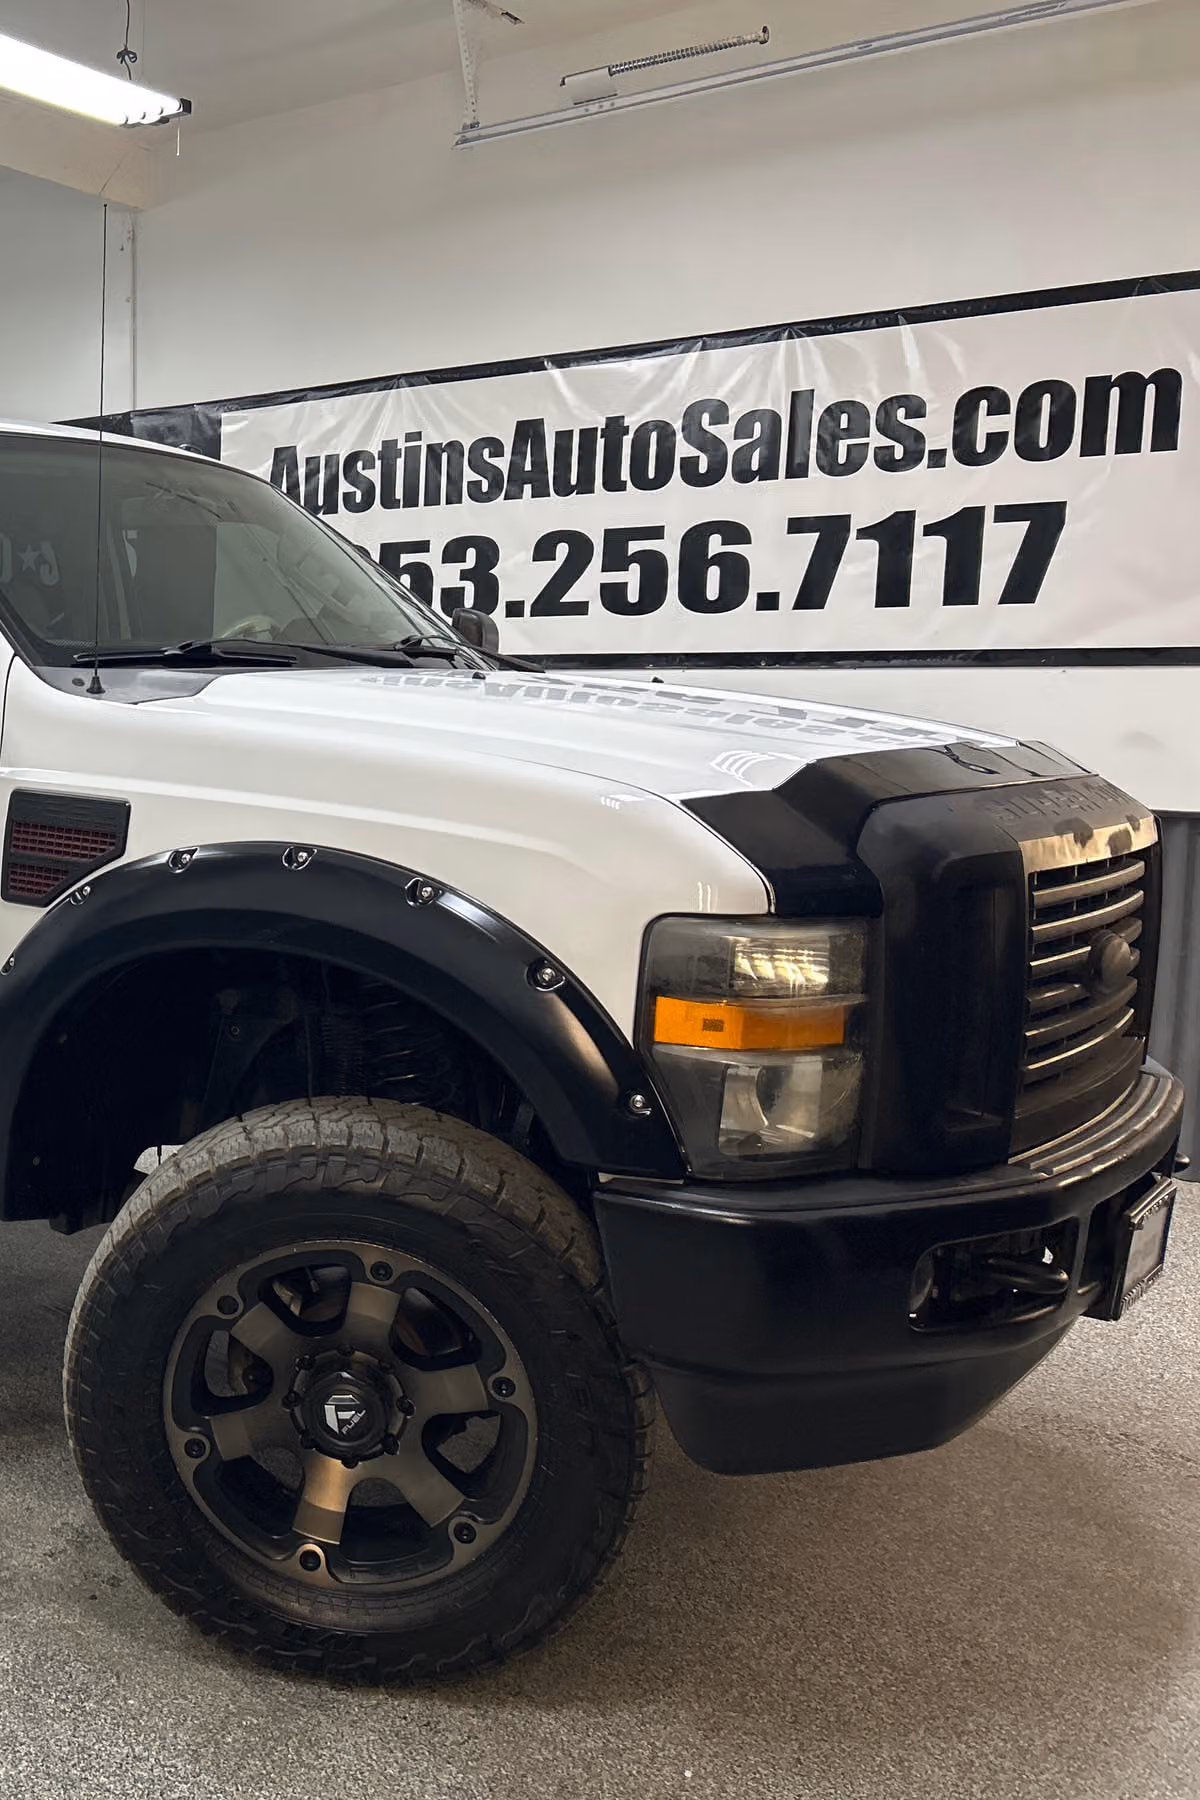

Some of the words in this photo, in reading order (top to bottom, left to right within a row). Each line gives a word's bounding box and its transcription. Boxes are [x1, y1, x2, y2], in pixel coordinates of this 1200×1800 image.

[270, 367, 1183, 516] AustinsAutoSales.com
[355, 500, 1068, 618] 53.256.7117
[341, 1409, 367, 1435] FUEL
